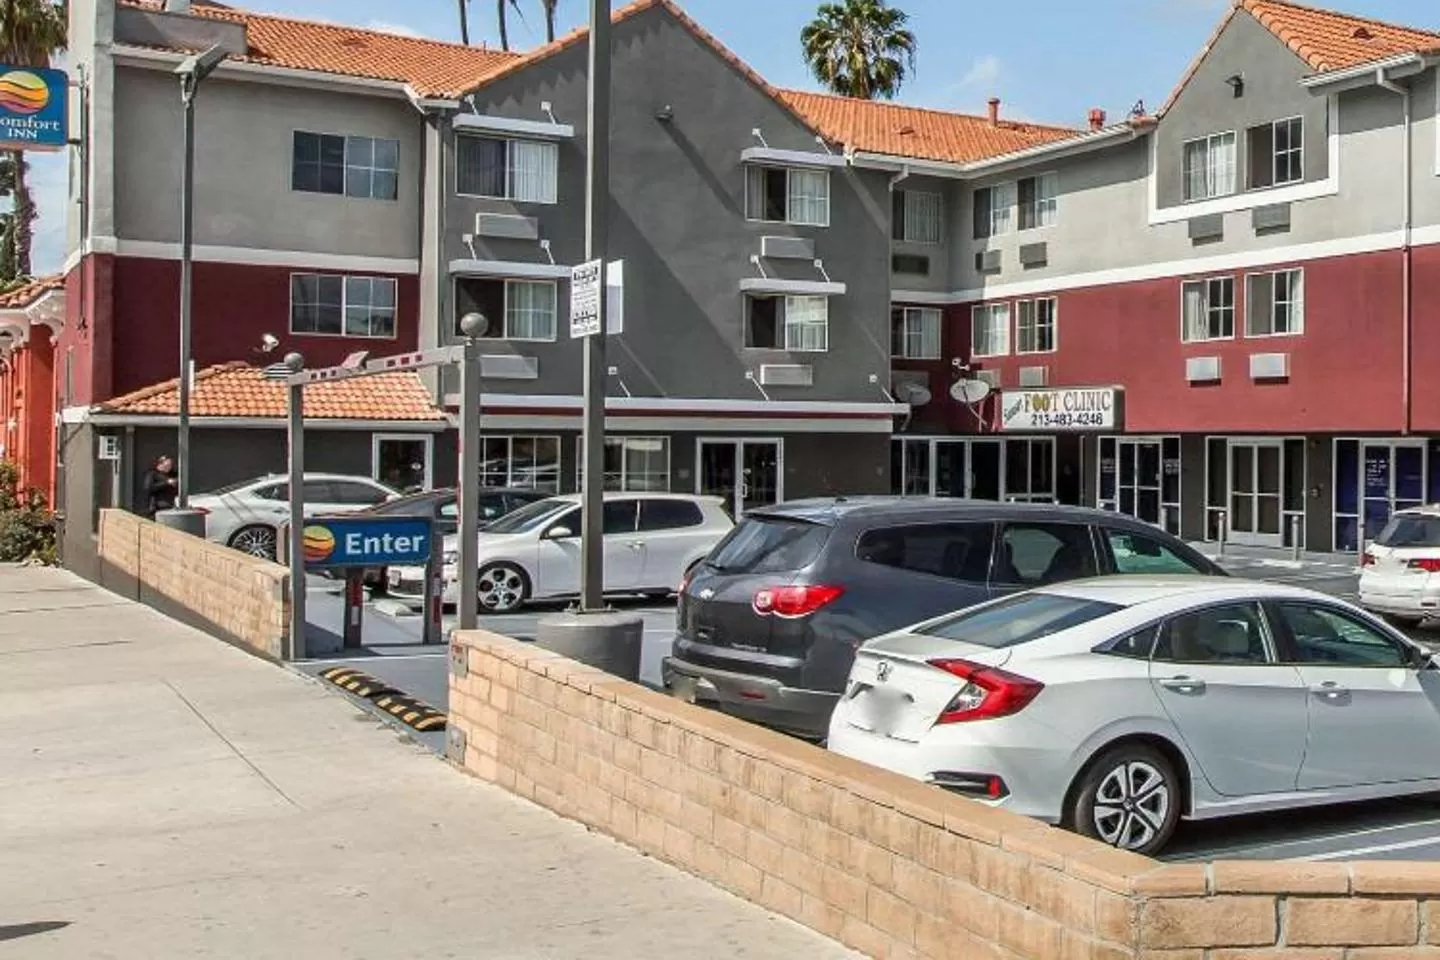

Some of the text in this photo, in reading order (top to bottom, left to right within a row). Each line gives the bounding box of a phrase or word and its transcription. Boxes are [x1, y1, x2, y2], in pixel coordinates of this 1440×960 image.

[0, 114, 60, 132] omfort
[8, 128, 38, 139] INN
[1024, 393, 1058, 413] FOOT
[1063, 391, 1111, 412] CLINIC
[345, 532, 424, 556] Enter
